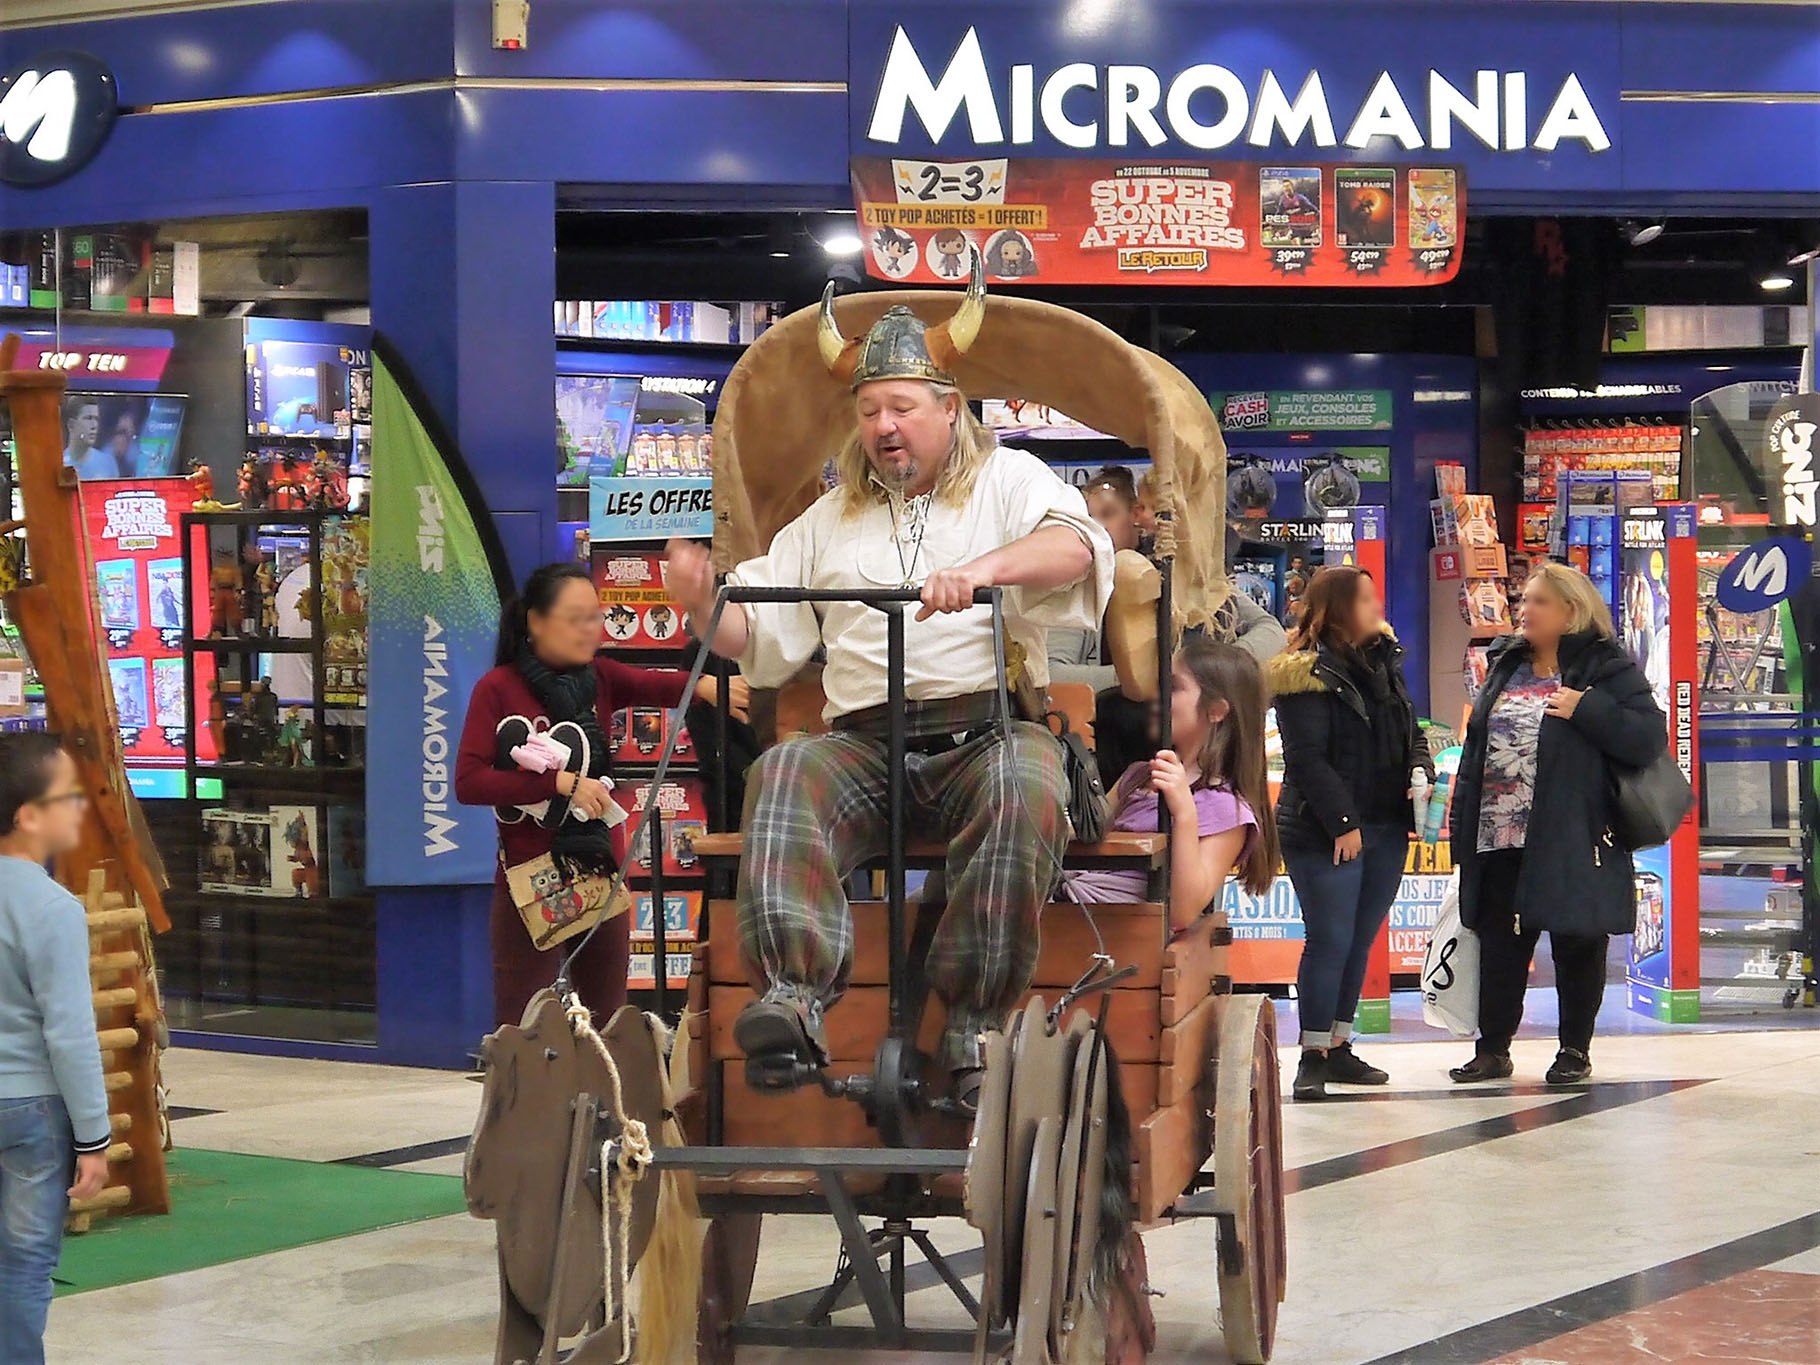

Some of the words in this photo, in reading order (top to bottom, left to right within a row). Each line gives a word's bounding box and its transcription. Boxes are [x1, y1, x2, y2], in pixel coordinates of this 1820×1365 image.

[867, 24, 1613, 152] MICROMANIA
[1123, 167, 1132, 176] 22
[917, 165, 985, 201] 2=3
[1363, 181, 1391, 189] RAIDER
[1090, 178, 1233, 208] SUPER
[876, 208, 896, 224] TOY
[900, 208, 922, 224] POP
[925, 206, 976, 225] ACHETÉS
[1094, 203, 1230, 227] BONNES
[1265, 214, 1289, 223] PES
[1079, 224, 1246, 249] AFFAIRES
[1121, 252, 1142, 267] LE
[1142, 251, 1204, 268] RETOUR
[38, 352, 82, 370] TOP
[87, 353, 128, 372] TEN
[1291, 393, 1355, 403] REVENDANT
[1224, 401, 1269, 417] CASH
[1275, 403, 1309, 415] JEUX,
[1311, 403, 1377, 414] CONSOLES
[1224, 413, 1269, 430] AVOIR
[1289, 415, 1373, 426] ACCESSOIRES
[1769, 434, 1781, 452] POP
[104, 498, 168, 515] SUPER
[606, 490, 644, 517] LES
[625, 518, 639, 531] DE
[641, 518, 652, 530] LA
[655, 517, 701, 529] SEMAINE
[1676, 681, 1692, 706] RED
[1676, 706, 1692, 738] DEAD
